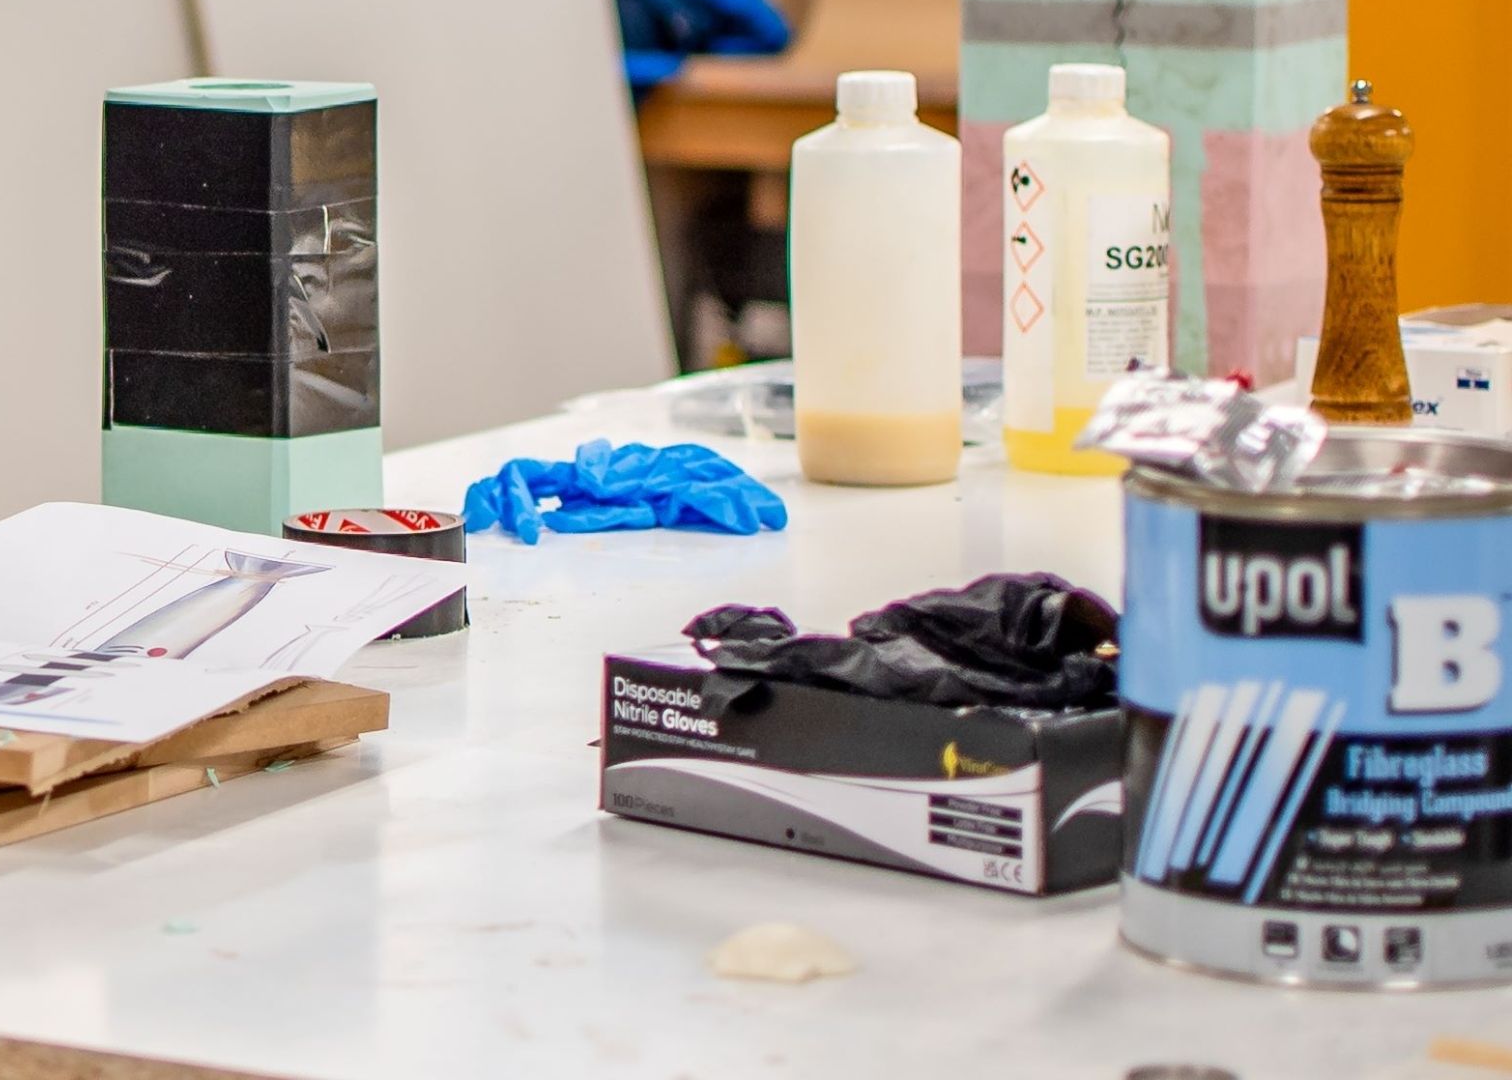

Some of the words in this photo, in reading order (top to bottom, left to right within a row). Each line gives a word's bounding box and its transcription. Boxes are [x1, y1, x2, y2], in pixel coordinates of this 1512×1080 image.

[1204, 544, 1357, 637] upol
[1386, 595, 1504, 717] B
[614, 676, 701, 709] Disposable
[614, 700, 659, 725] Nitrile
[661, 709, 718, 736] Gloves
[1346, 742, 1487, 787] Fibreglass
[613, 792, 635, 809] 100
[1326, 784, 1416, 824] Bridging
